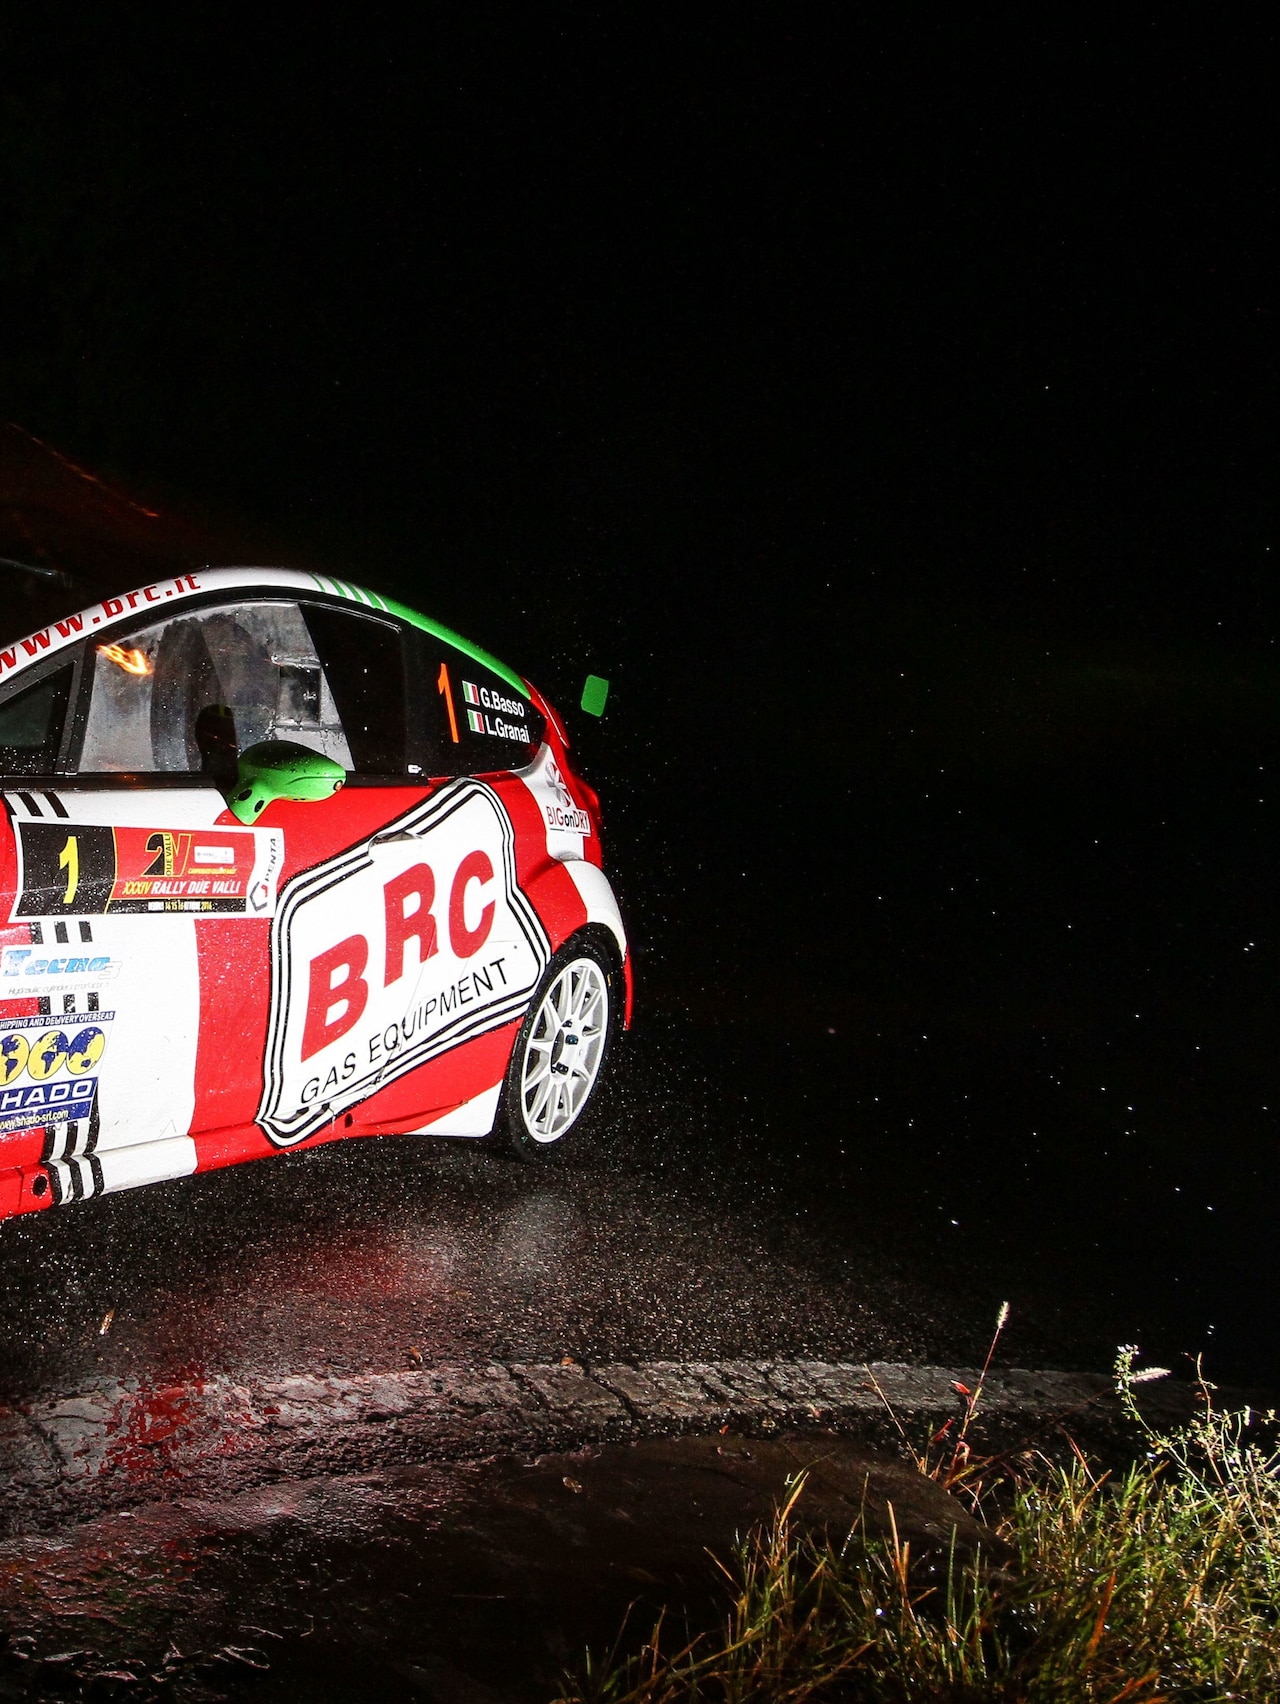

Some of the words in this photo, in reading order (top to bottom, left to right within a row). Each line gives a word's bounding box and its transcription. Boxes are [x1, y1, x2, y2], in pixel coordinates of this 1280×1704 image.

[437, 663, 459, 743] 1
[480, 687, 525, 717] G.Basso
[485, 715, 531, 743] L.Granai
[58, 835, 80, 904] 1
[122, 882, 152, 895] XXXIV
[151, 881, 186, 895] RALLY
[187, 881, 210, 894] DUE
[211, 881, 242, 894] VALLI
[300, 850, 496, 1063] BRC
[29, 1017, 45, 1027] AND
[45, 1014, 80, 1026] DELIVERY
[79, 1012, 114, 1022] OVERSEAS
[300, 1052, 356, 1104] GAS
[369, 957, 509, 1064] EQUIPMENT
